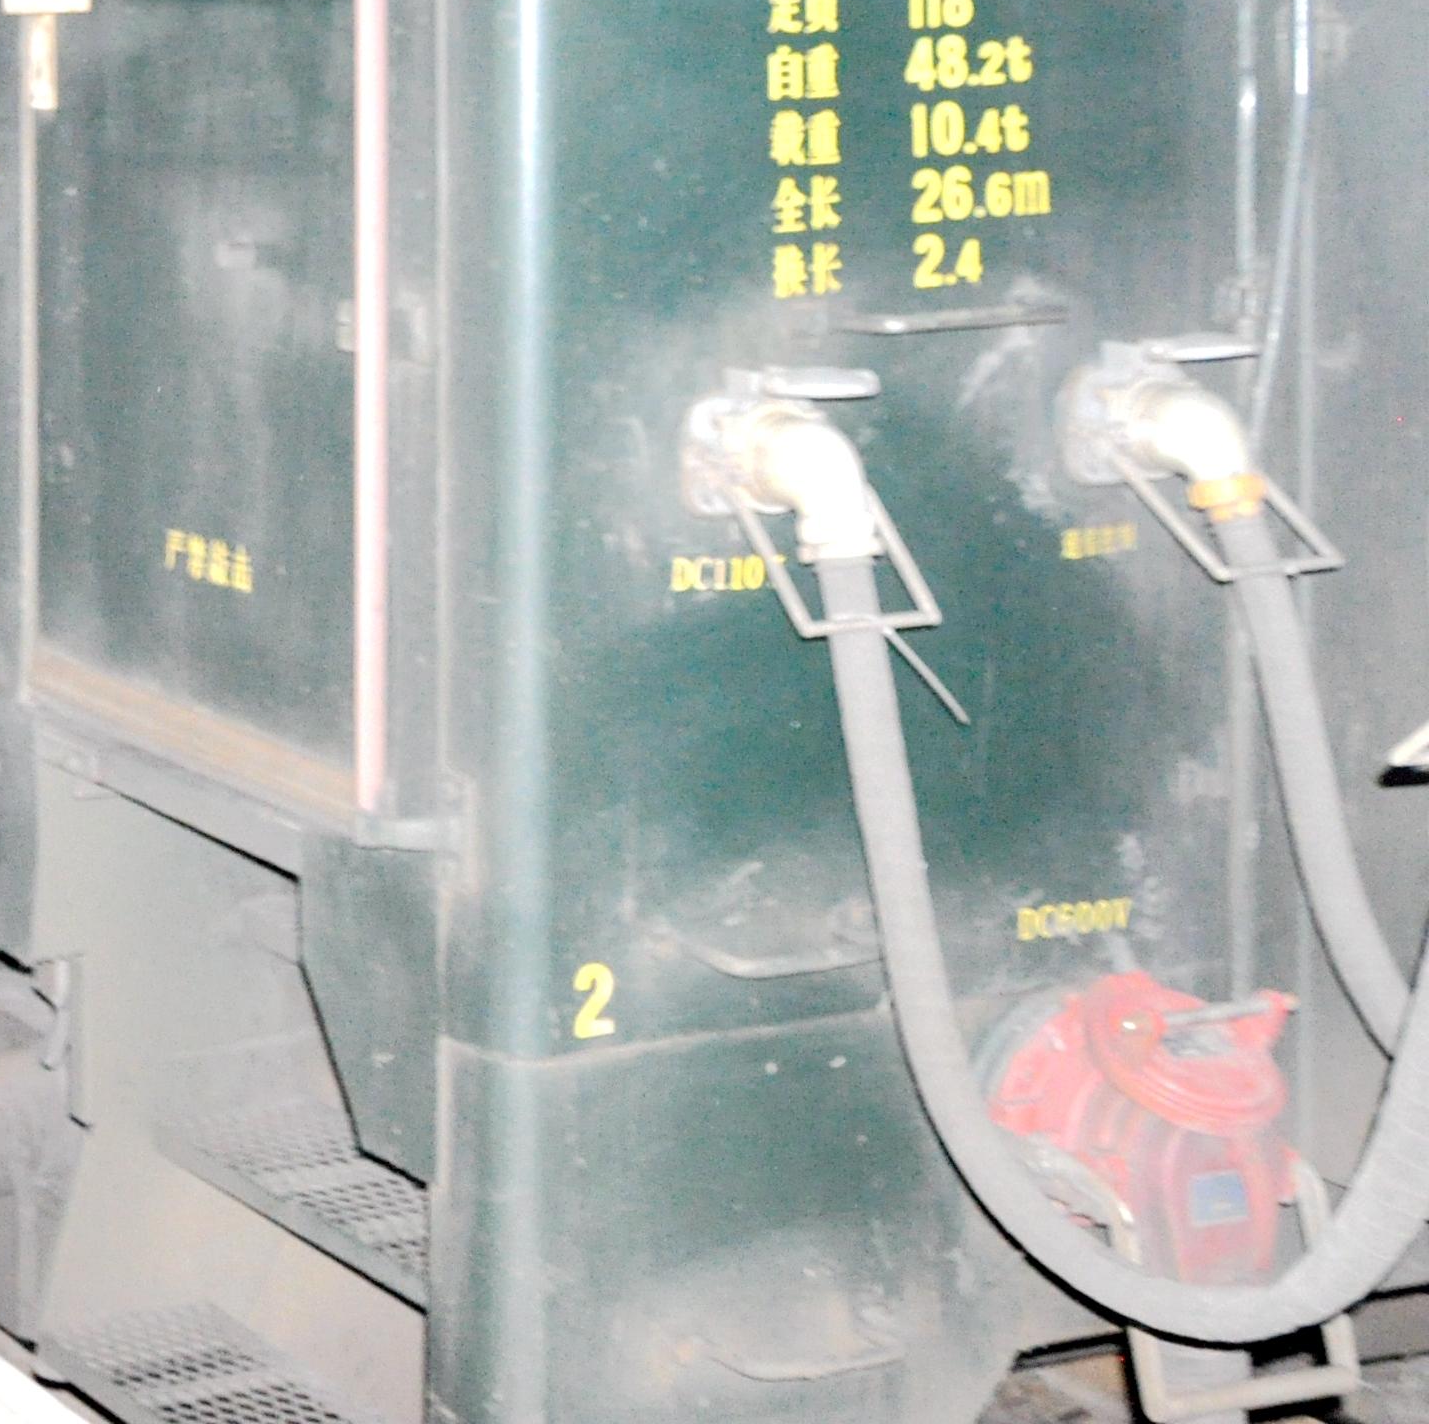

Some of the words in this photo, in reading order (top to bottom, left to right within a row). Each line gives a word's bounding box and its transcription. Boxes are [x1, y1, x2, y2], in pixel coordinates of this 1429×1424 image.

[766, 43, 840, 101] 自重
[904, 34, 1033, 92] 48.2t
[768, 109, 841, 167] 载重
[910, 100, 1030, 158] 10.4t
[772, 175, 842, 234] 全长
[910, 165, 1051, 224] 26.6m
[912, 233, 983, 289] 2.4
[573, 962, 616, 1040] 2
